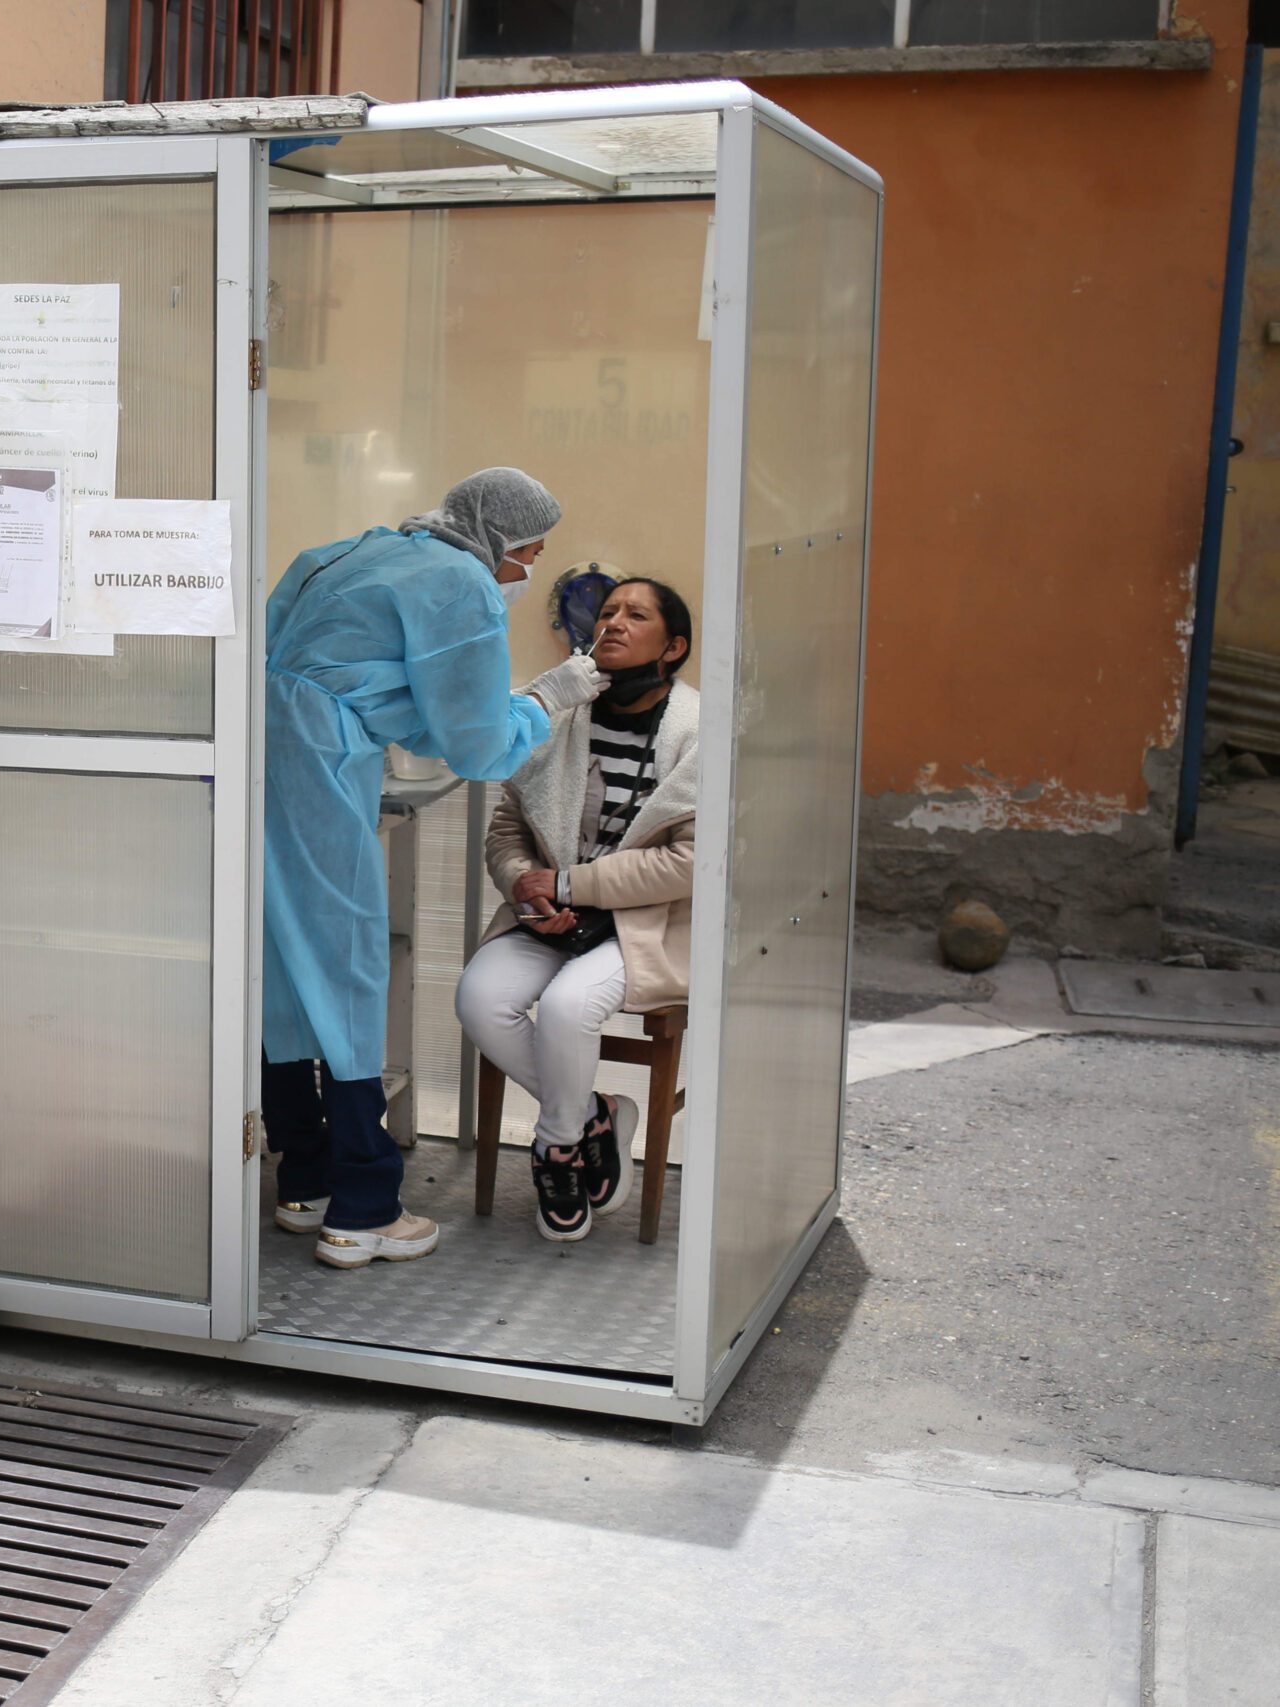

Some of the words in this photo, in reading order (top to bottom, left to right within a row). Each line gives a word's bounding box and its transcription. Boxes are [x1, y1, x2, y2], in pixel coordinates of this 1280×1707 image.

[14, 295, 40, 303] SEDES
[597, 357, 627, 409] 5
[24, 448, 35, 456] de
[88, 488, 109, 497] virus
[89, 530, 111, 538] PARA
[114, 531, 141, 539] TOMA
[143, 531, 154, 539] DE
[156, 531, 199, 540] MUESTRA:
[94, 573, 162, 587] UTILIZAR
[167, 574, 224, 590] BARBIJO
